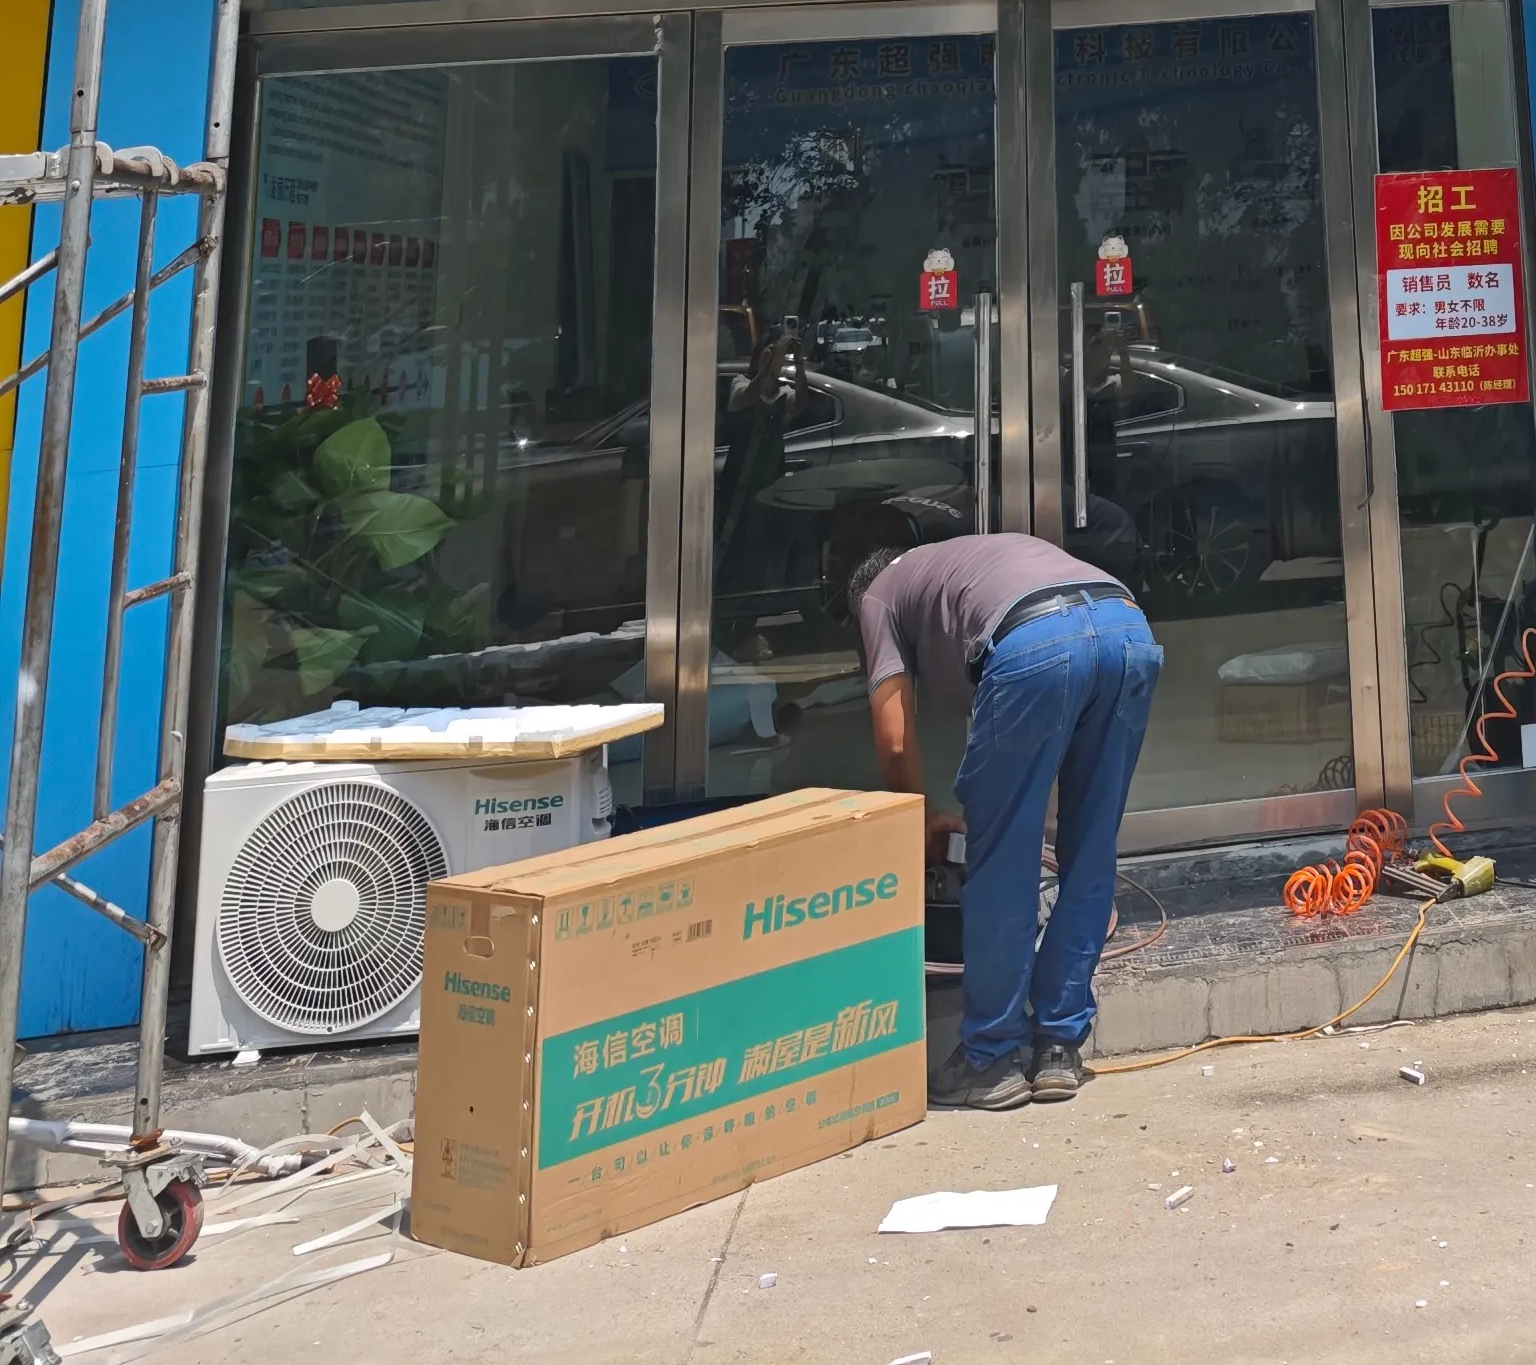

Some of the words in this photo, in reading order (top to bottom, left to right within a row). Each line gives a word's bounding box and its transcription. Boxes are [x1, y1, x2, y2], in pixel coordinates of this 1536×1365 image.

[1418, 185, 1477, 214] 招工
[1390, 218, 1505, 241] 因公司发展需要
[1399, 240, 1498, 260] 现向社会招聘
[1103, 262, 1126, 287] 拉
[1402, 274, 1452, 294] 销售员
[1467, 271, 1499, 290] 数名
[927, 275, 951, 300] 拉
[1434, 298, 1485, 315] 男女不限
[1435, 313, 1508, 330] 年龄20-38岁
[1387, 342, 1520, 364] 广东超强-山东临沂办事处
[1433, 364, 1480, 378] 联系电话
[1394, 383, 1414, 396] 150
[1417, 382, 1436, 395] 171
[1439, 380, 1474, 393] 43110
[474, 793, 563, 815] Hisense
[483, 813, 552, 832] 海信空调
[742, 871, 899, 942] Hisense
[444, 971, 511, 1004] Hisense
[573, 1012, 684, 1080] 海信空调
[568, 1056, 727, 1144] 开机3分钟
[737, 997, 899, 1086] 满屋是新风
